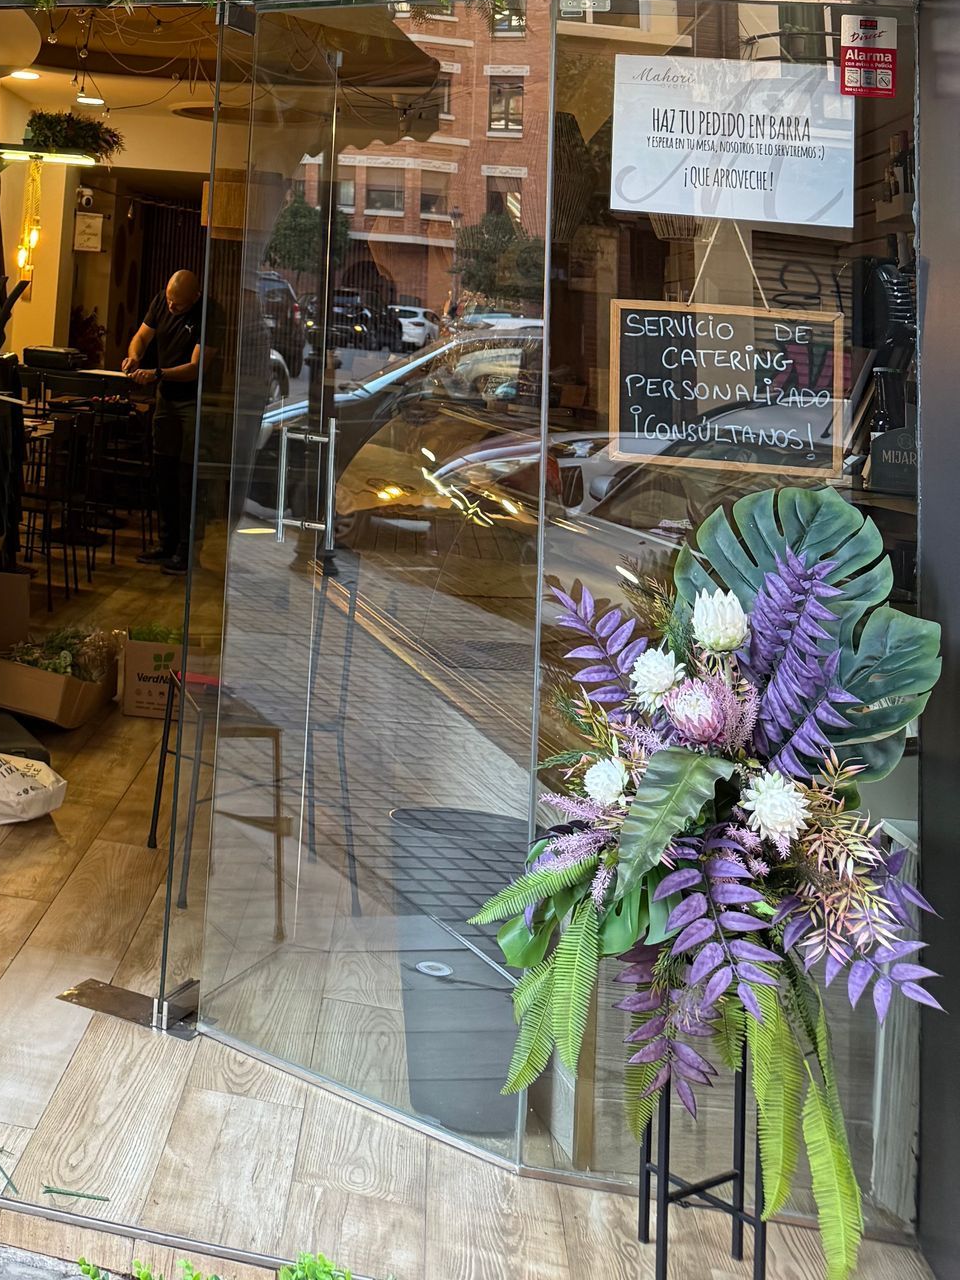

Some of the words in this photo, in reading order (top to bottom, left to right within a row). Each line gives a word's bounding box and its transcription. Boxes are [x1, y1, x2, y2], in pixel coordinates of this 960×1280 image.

[845, 49, 893, 62] Alarma
[632, 67, 696, 83] Mahori
[652, 107, 676, 134] HAZ
[679, 109, 695, 135] TU
[699, 111, 744, 139] PEDIDO
[749, 114, 765, 140] EN
[769, 115, 810, 142] BARRA
[646, 136, 651, 148] Y
[651, 136, 674, 150] ESPERA
[675, 137, 685, 150] EN
[687, 138, 696, 150] TU
[696, 139, 718, 154] MESA,
[719, 141, 754, 155] NOSOTROS
[756, 143, 763, 155] TE
[764, 143, 773, 156] LO
[774, 144, 817, 159] SERVIREMOS
[690, 166, 710, 188] QUE
[713, 168, 767, 191] APROVECHE
[624, 313, 734, 340] SERVICIO
[774, 323, 813, 344] DE
[661, 344, 793, 371] CATERING
